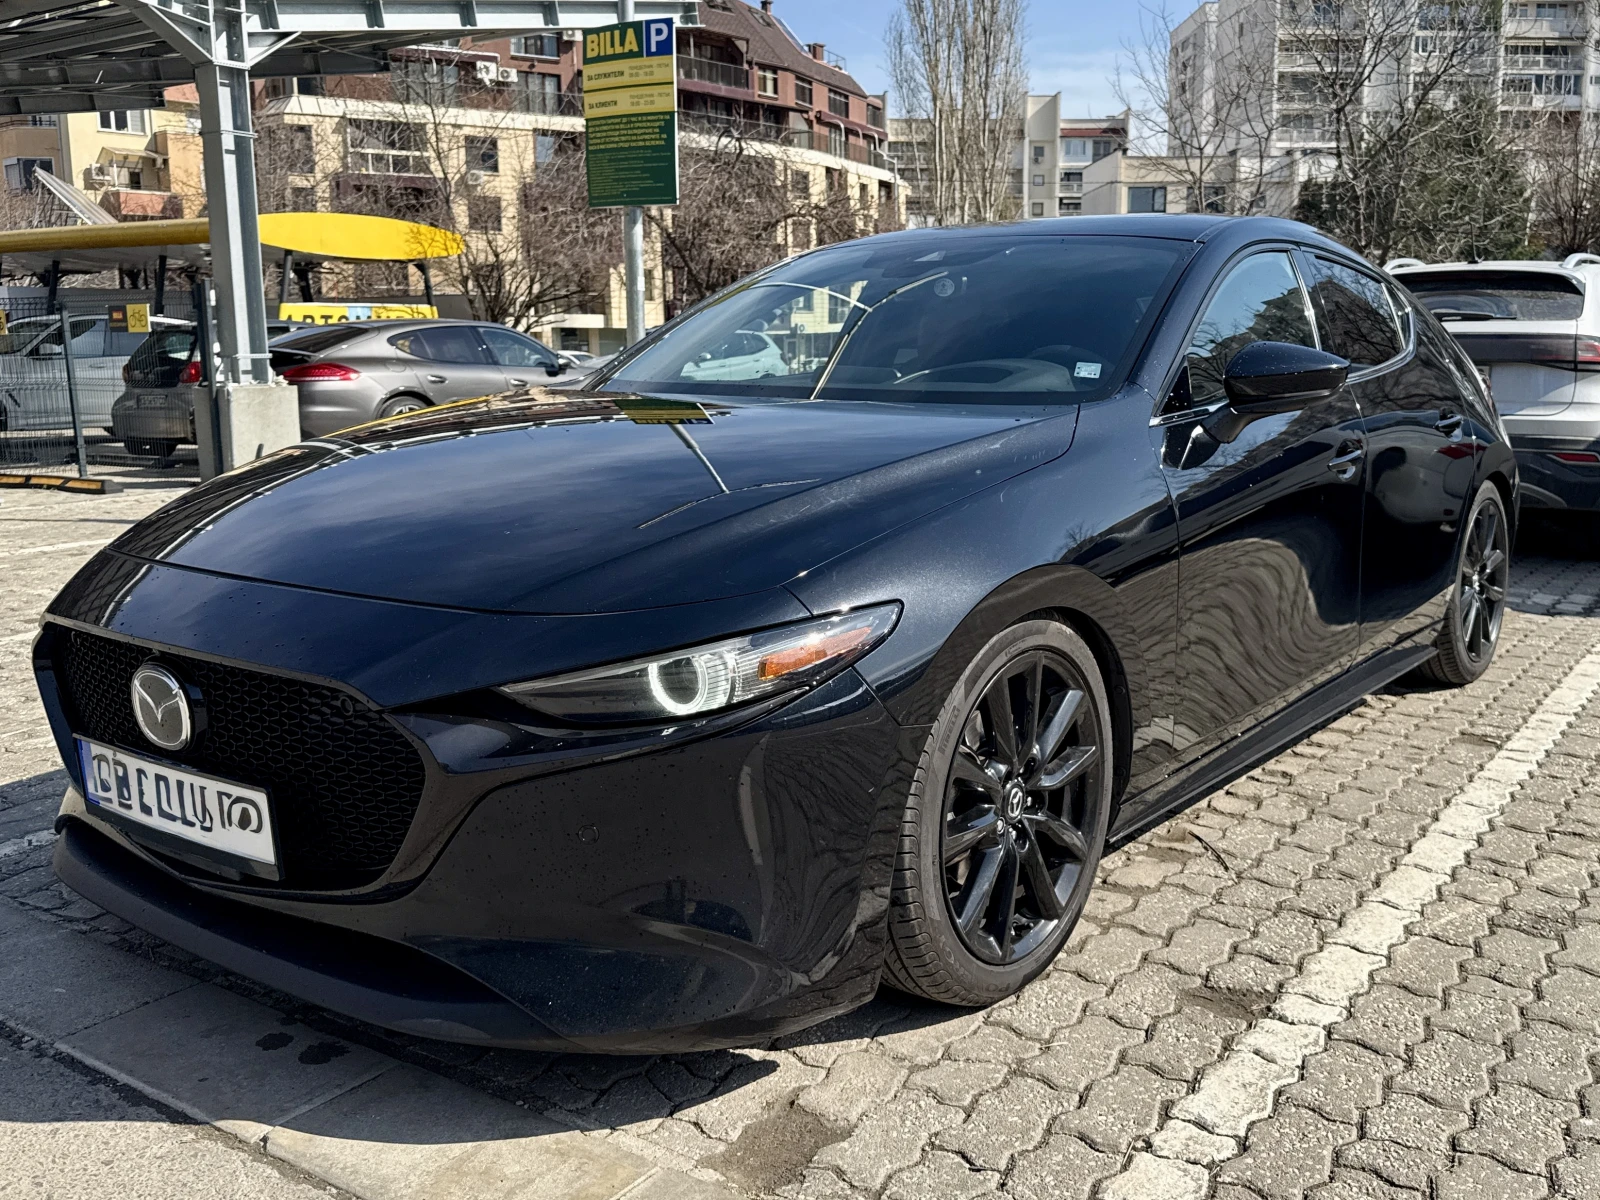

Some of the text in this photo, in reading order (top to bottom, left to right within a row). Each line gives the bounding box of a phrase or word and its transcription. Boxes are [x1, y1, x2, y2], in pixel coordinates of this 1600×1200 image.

[586, 28, 639, 58] BILLA
[650, 23, 669, 52] P
[594, 71, 624, 80] СЛУЖИТЕЛИ
[596, 100, 617, 108] КЛИЕНТИ
